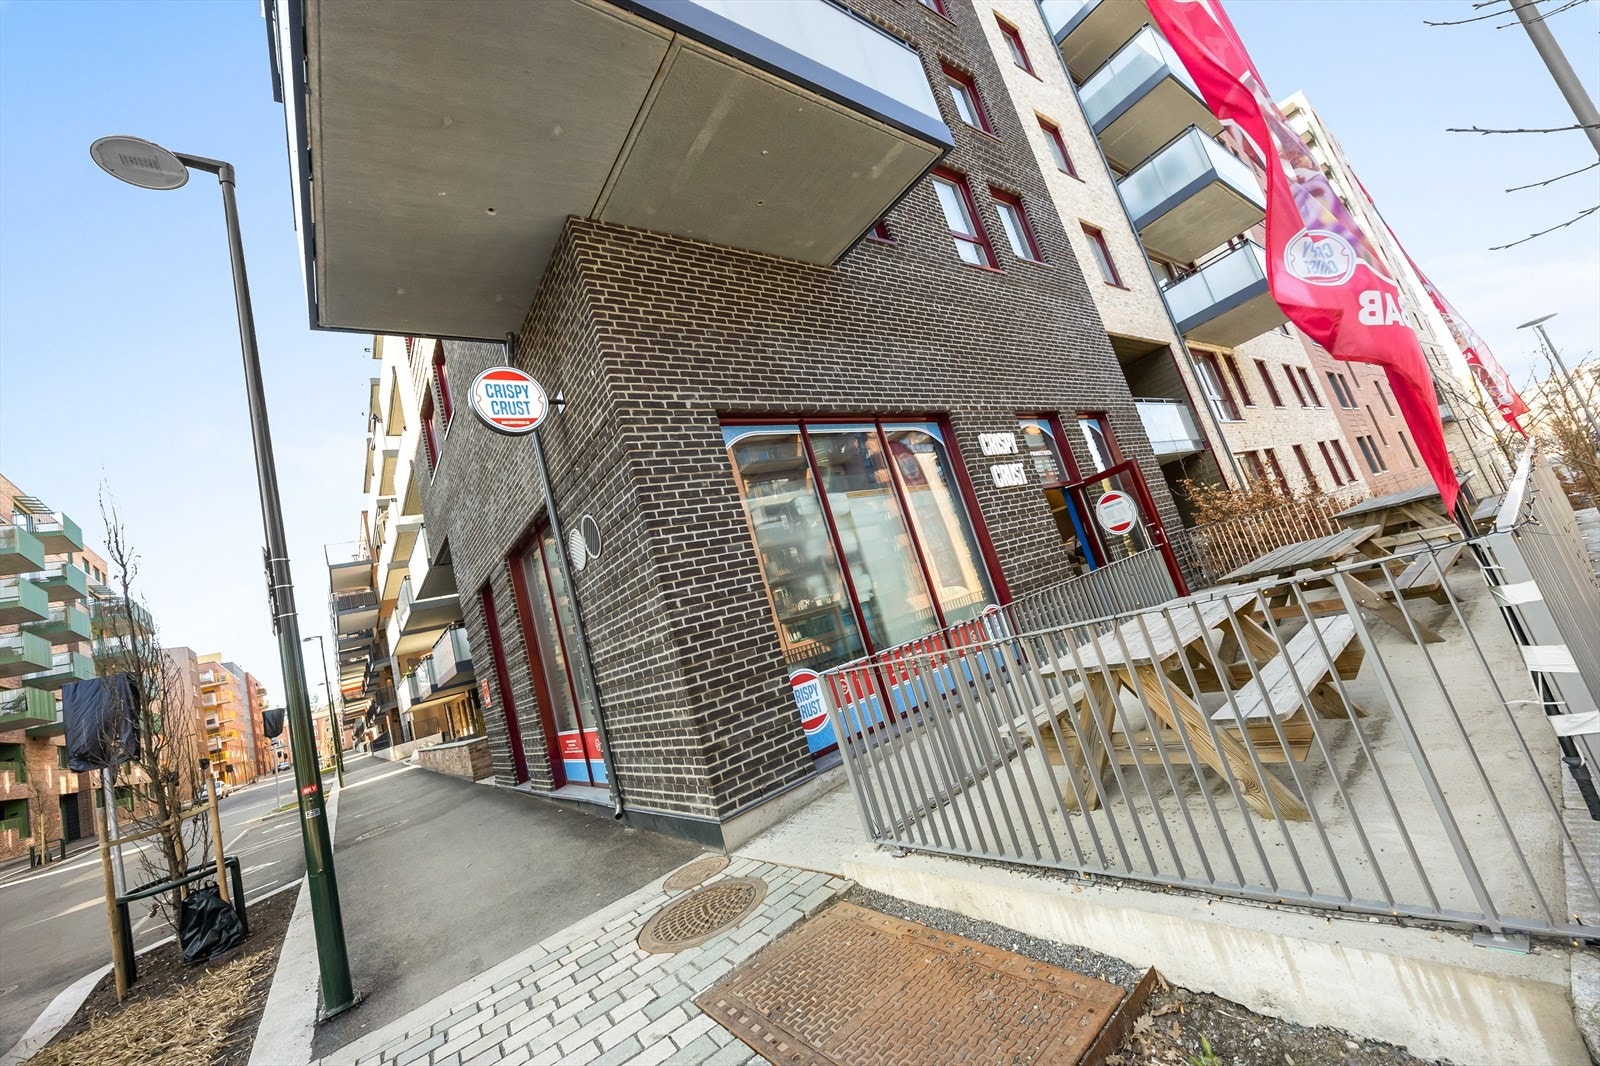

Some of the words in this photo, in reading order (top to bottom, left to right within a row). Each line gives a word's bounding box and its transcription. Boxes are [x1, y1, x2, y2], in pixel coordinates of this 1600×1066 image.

[485, 383, 529, 399] CRISPY
[491, 401, 530, 415] CRUST
[978, 433, 1018, 455] CRISPY
[990, 463, 1028, 487] CRUST
[794, 682, 819, 704] RISPY
[800, 699, 822, 720] RUST
